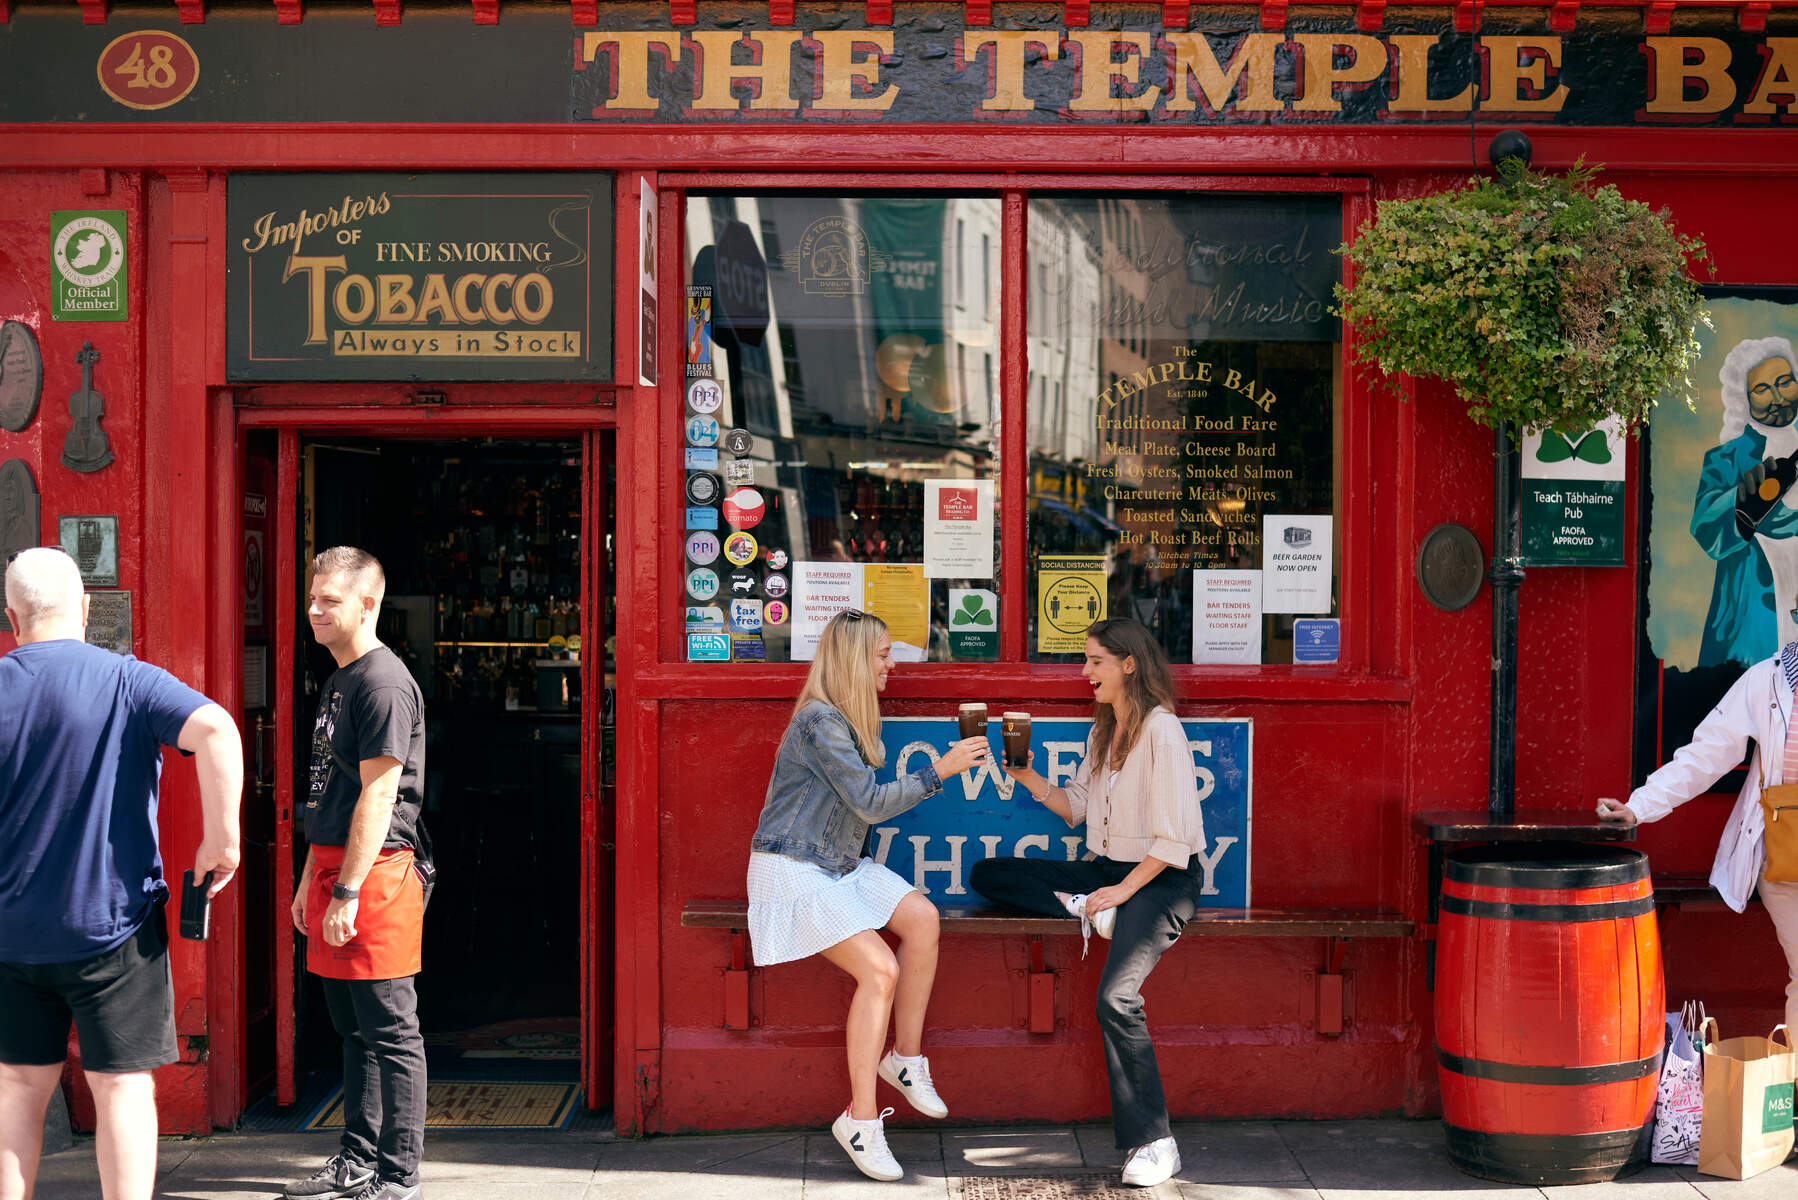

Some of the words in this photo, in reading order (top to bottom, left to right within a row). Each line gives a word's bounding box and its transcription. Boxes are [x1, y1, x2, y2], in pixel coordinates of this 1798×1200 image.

[114, 42, 178, 89] 48
[580, 30, 900, 114] THE
[962, 31, 1570, 115] TEMPLE
[77, 220, 117, 241] IRELAND
[242, 193, 391, 254] Importers
[336, 229, 362, 245] OF
[376, 242, 432, 263] FINE
[438, 241, 553, 263] SMOKING
[802, 235, 816, 258] THE
[68, 287, 111, 298] Official
[687, 290, 703, 298] TEMPLE
[702, 290, 712, 298] BAR
[64, 298, 115, 309] Member
[283, 254, 554, 346] TOBACCO
[338, 332, 441, 354] Always
[457, 334, 480, 351] in
[494, 331, 575, 352] Stock
[1172, 345, 1197, 357] The
[686, 369, 712, 377] FESTIVAL
[1096, 360, 1213, 409] TEMPLE
[1222, 368, 1277, 413] BAR
[1167, 390, 1183, 398] Est.
[1188, 390, 1208, 398] 1840
[1095, 414, 1187, 430] Traditional
[1194, 415, 1234, 430] Food
[1242, 416, 1278, 431] Fare
[1105, 442, 1137, 456] Meat
[1143, 442, 1180, 458] Plate,
[1185, 442, 1231, 456] Cheese
[1237, 443, 1276, 457] Board
[1087, 463, 1124, 477] Fresh
[1129, 464, 1181, 482] Oysters,
[1186, 464, 1238, 479] Smoked
[1244, 465, 1293, 479] Salmon
[1104, 486, 1183, 500] Charcuterie
[1236, 486, 1276, 501] Olives
[1533, 491, 1563, 503] Teach
[1564, 491, 1614, 505] Tábhairne
[728, 515, 758, 525] zomato
[1123, 508, 1175, 522] Toasted
[1180, 508, 1256, 523] Sandwiches
[1564, 507, 1584, 519] Pub
[1119, 530, 1144, 545] Hot
[1150, 530, 1186, 545] Roast
[1191, 530, 1221, 545] Beef
[1227, 531, 1260, 545] Rolls
[1561, 526, 1586, 535] FAOFA
[692, 542, 713, 553] PPI
[1553, 537, 1594, 545] APPROVED
[1272, 553, 1291, 561] BEER
[1291, 553, 1322, 561] GARDEN
[805, 571, 822, 579] STAFF
[693, 579, 713, 590] PPI
[735, 604, 756, 615] tax
[735, 615, 760, 627] free
[1768, 1096, 1793, 1112] M&S
